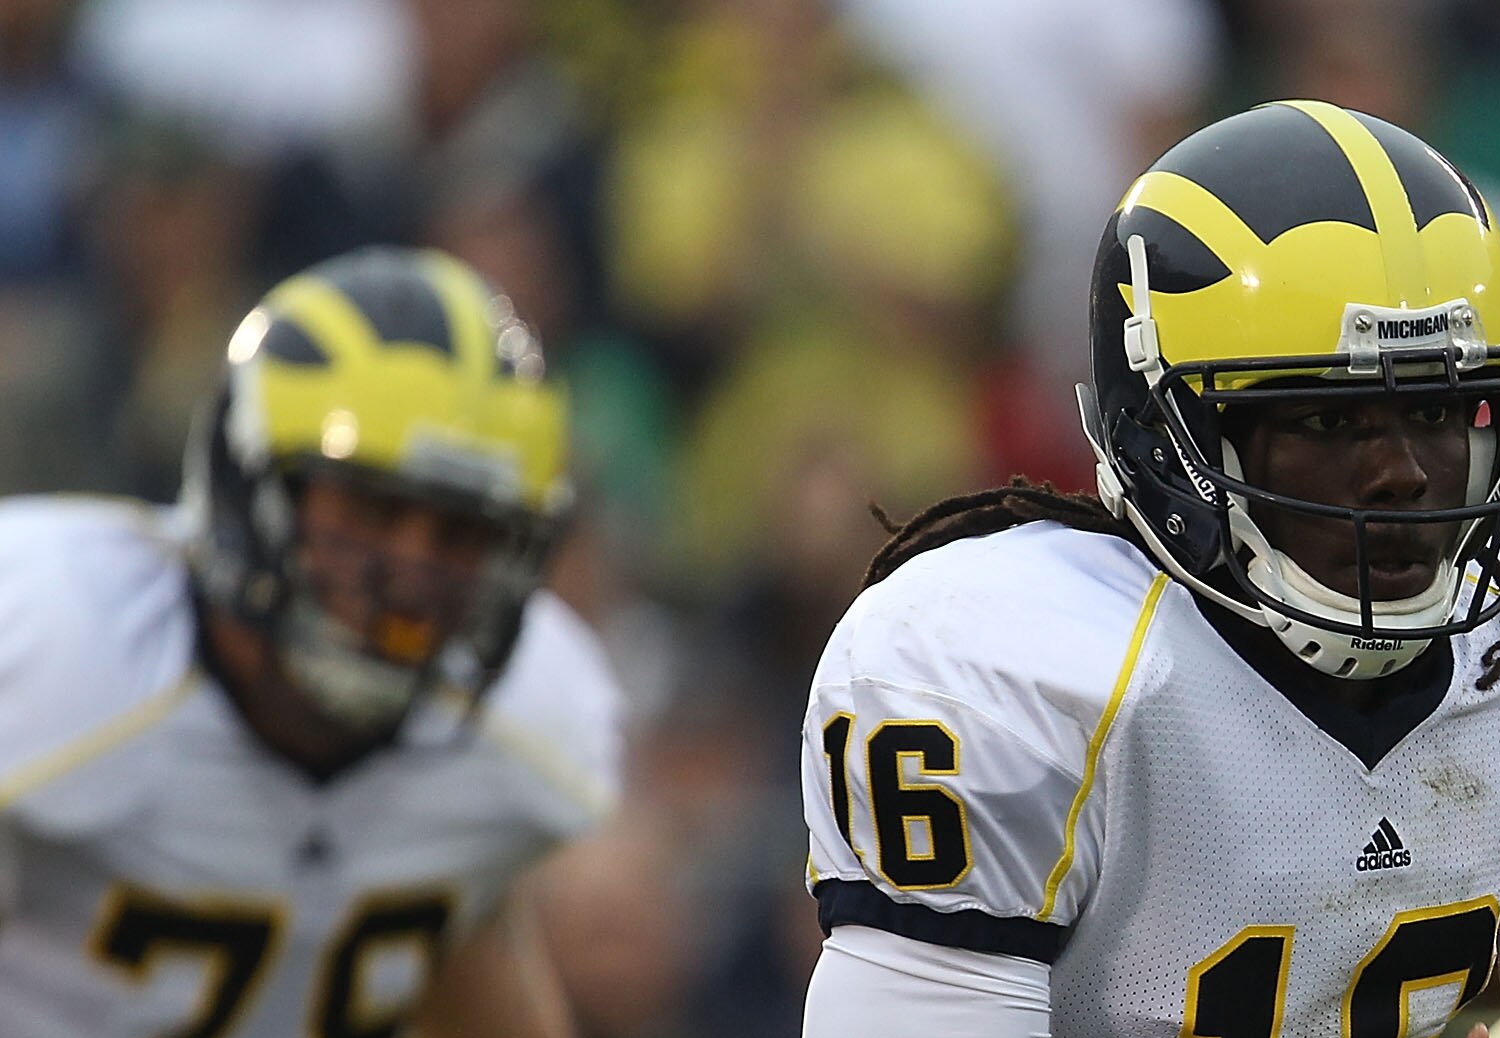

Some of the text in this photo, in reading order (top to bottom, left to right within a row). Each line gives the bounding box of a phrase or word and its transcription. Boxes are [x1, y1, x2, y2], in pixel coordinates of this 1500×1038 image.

[1377, 312, 1449, 339] MICHIGAN
[823, 711, 974, 892] 16
[1356, 849, 1412, 872] adidas
